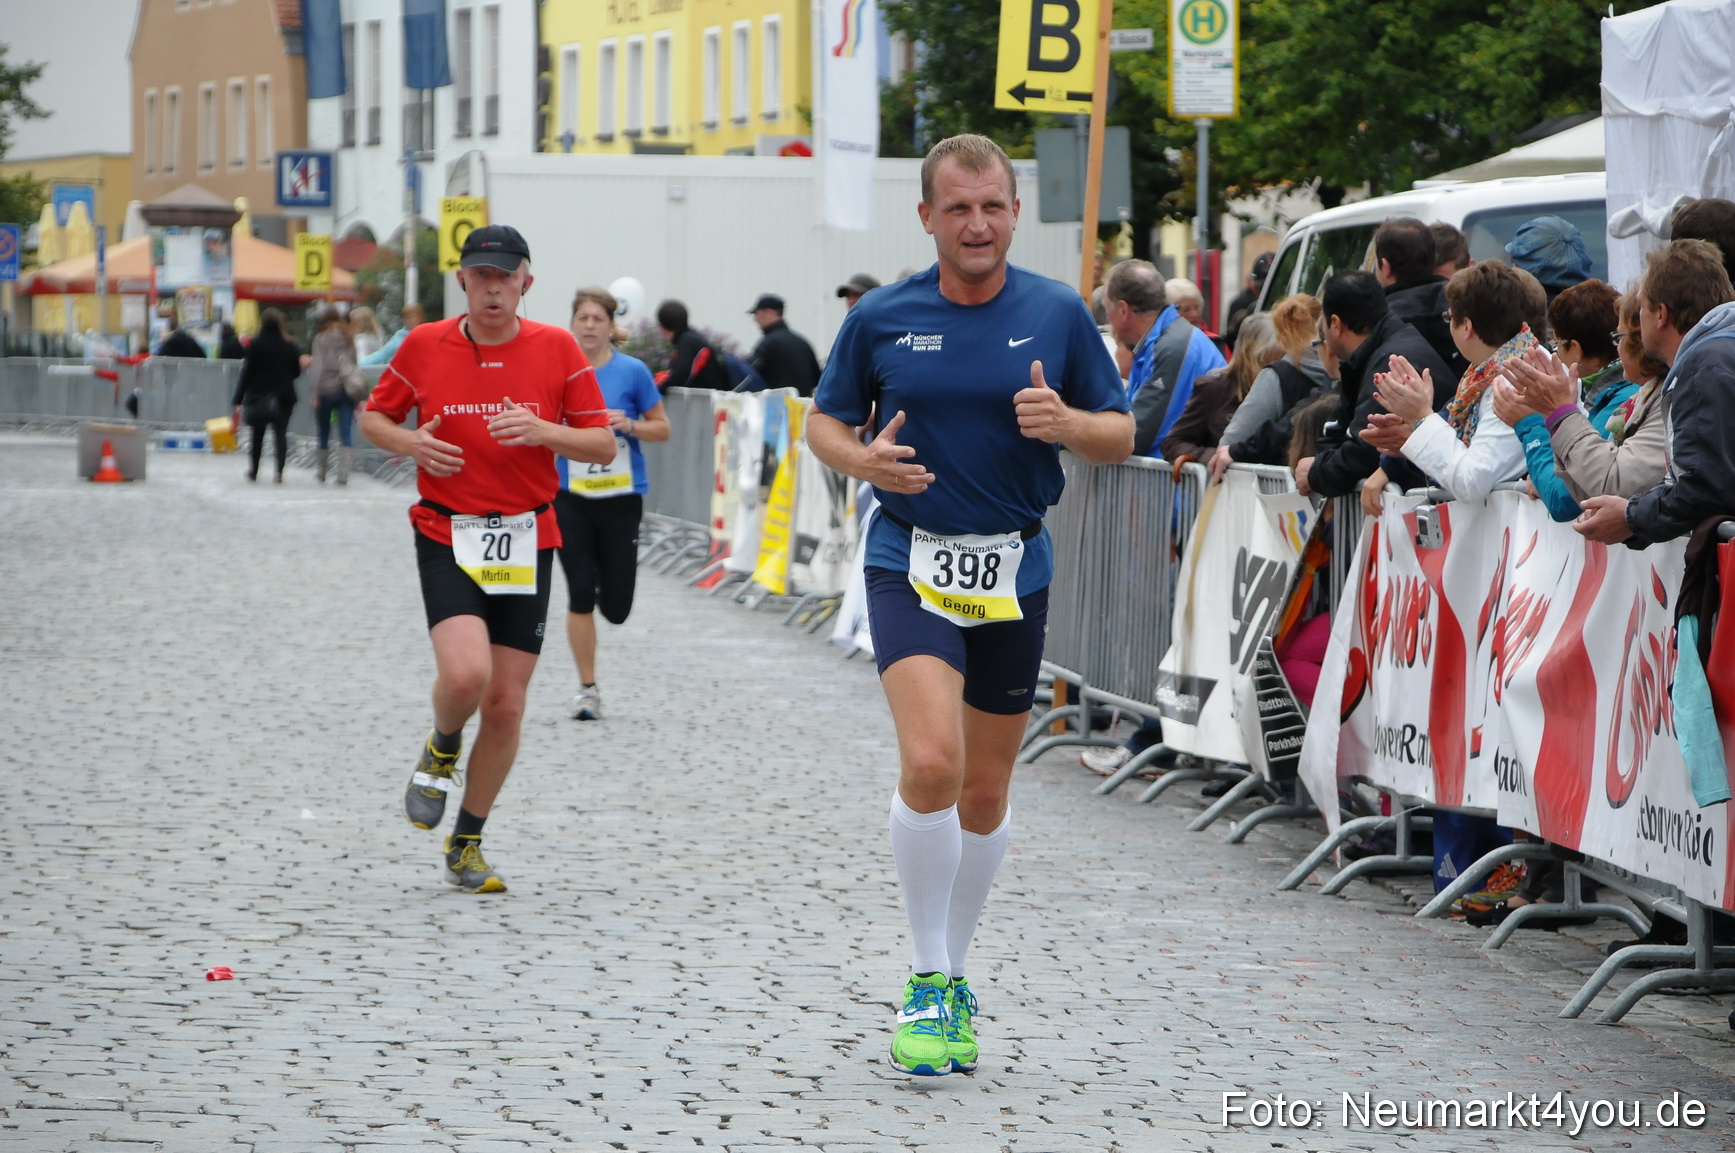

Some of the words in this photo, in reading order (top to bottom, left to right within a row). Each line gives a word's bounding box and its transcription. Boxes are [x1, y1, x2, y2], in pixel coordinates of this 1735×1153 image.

[1027, 0, 1081, 73] B
[443, 199, 481, 213] Block
[305, 250, 323, 276] D
[481, 532, 512, 561] 20
[481, 570, 510, 581] Martin
[932, 549, 1001, 591] 398
[943, 597, 986, 619] Georg
[1268, 735, 1305, 752] Parkhäu
